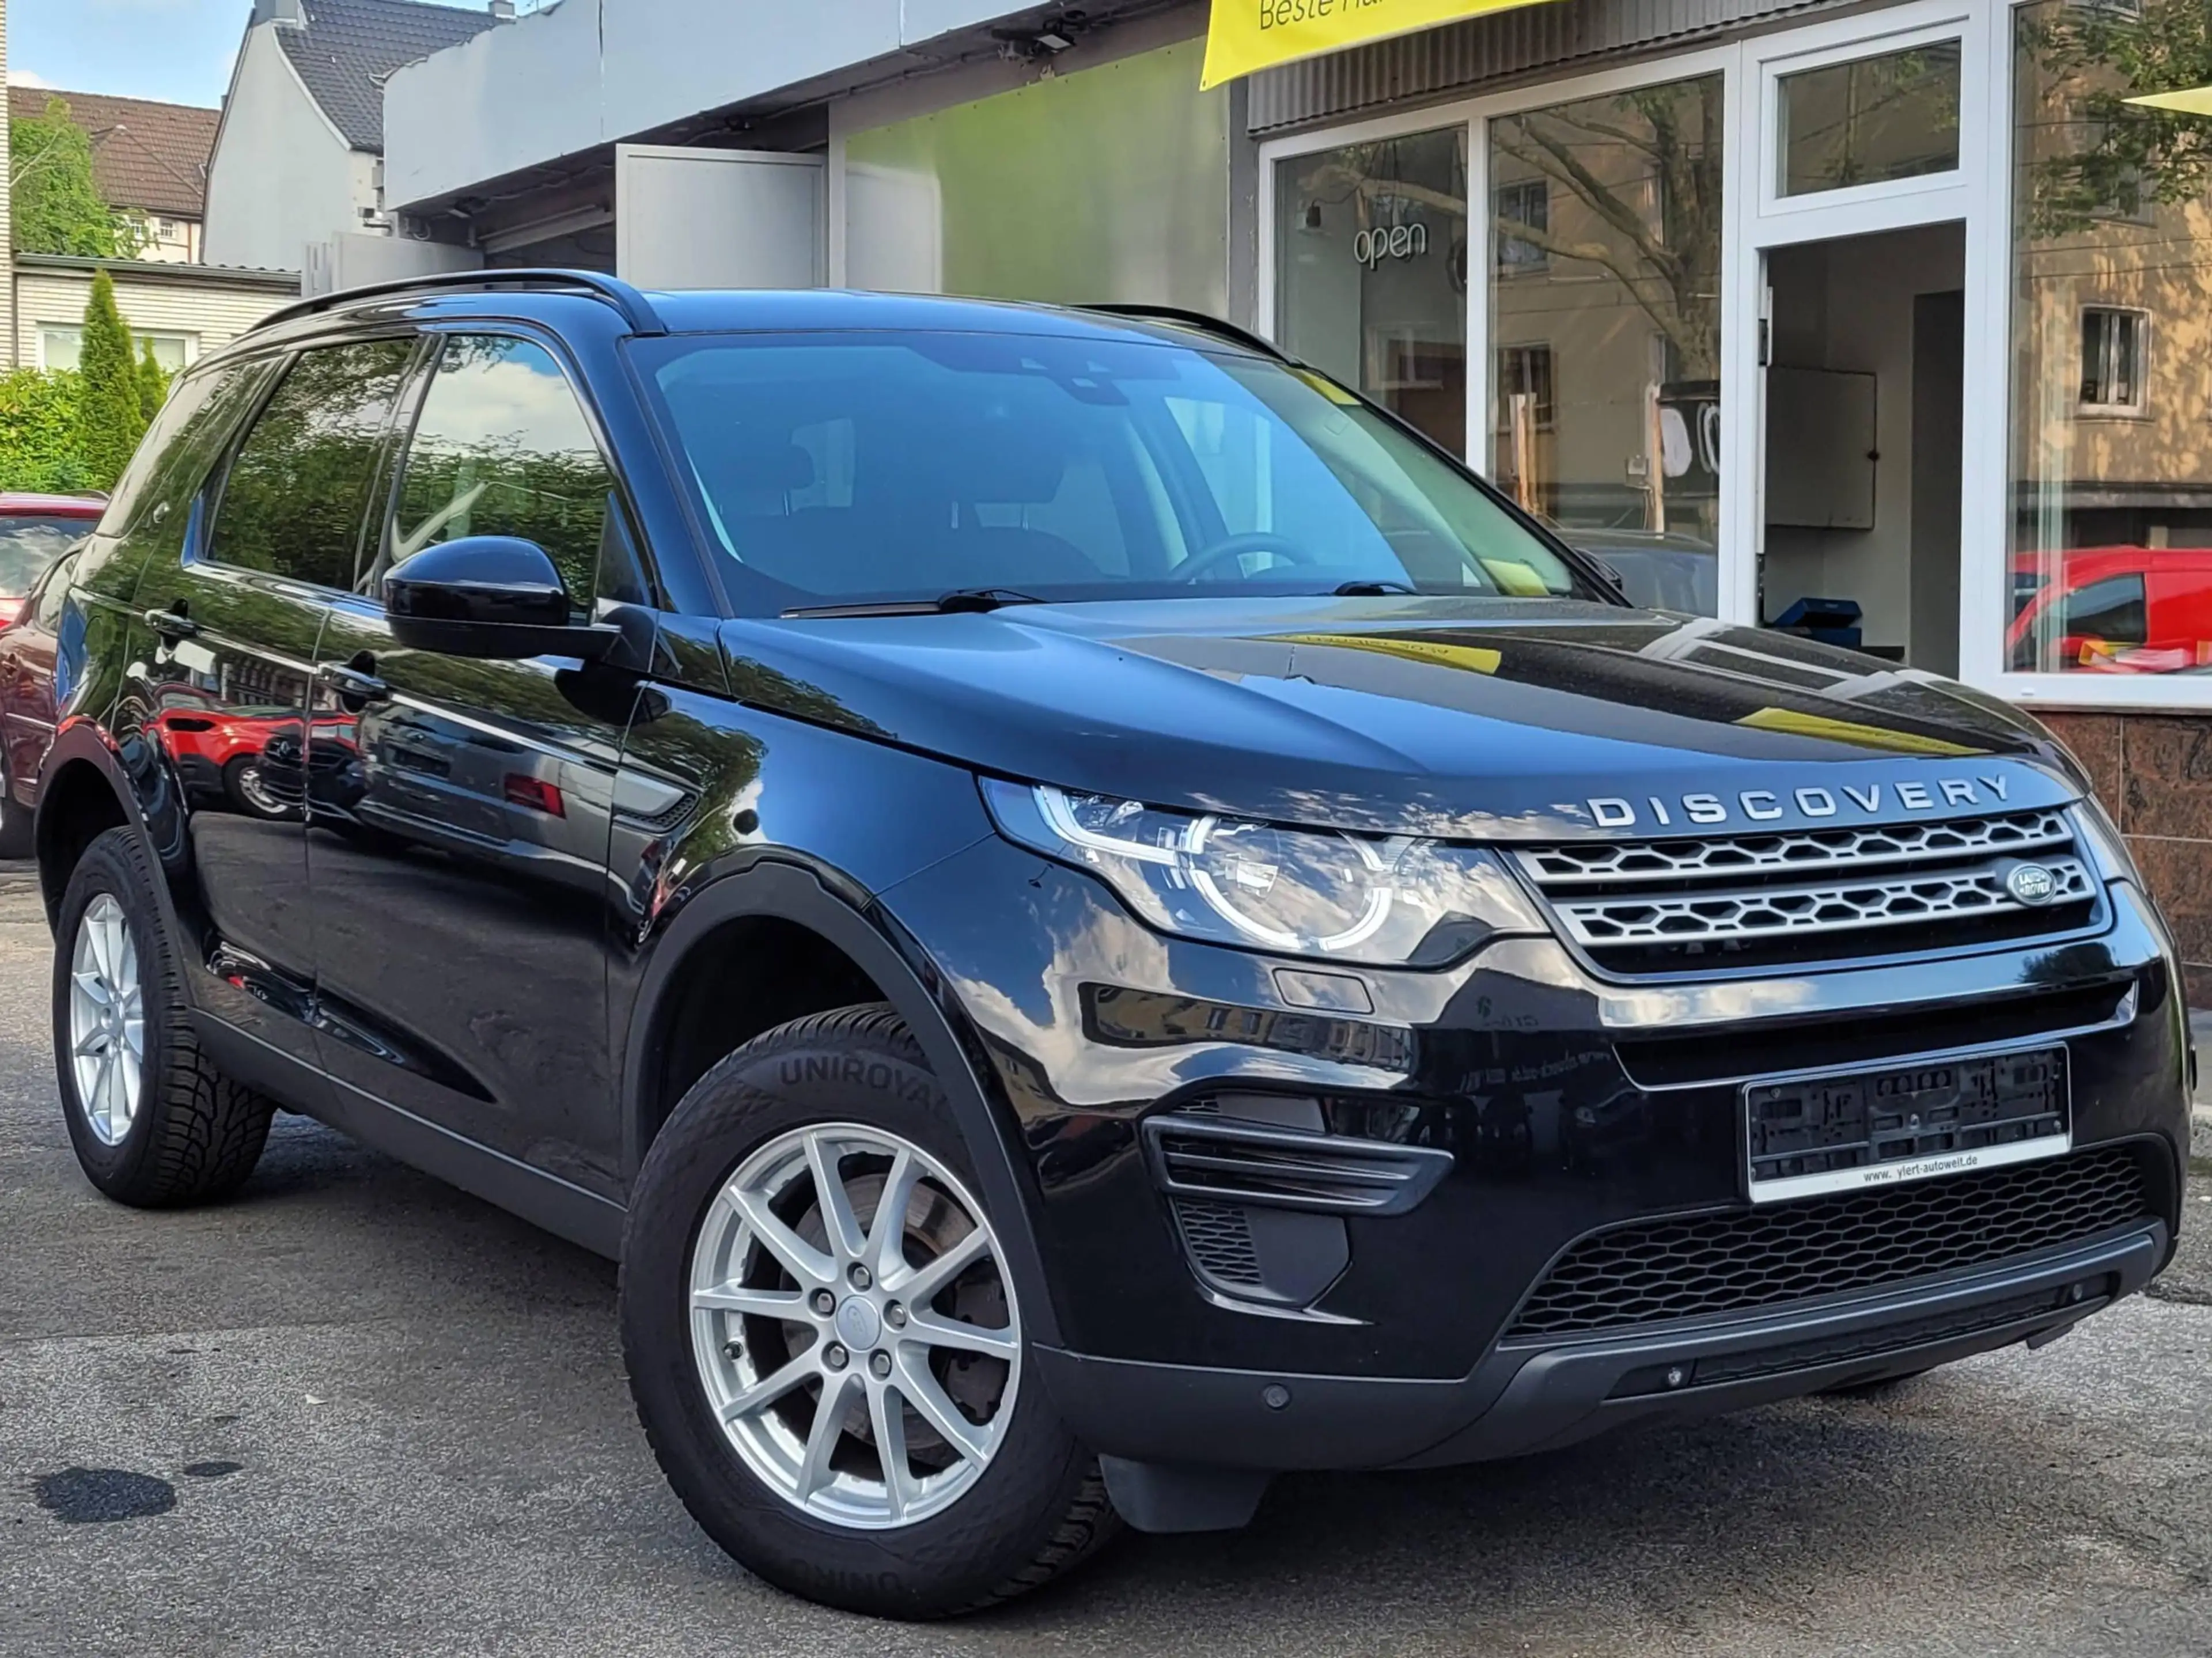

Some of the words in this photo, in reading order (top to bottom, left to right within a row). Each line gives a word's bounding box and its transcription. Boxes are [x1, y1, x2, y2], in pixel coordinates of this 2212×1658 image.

[1354, 223, 1426, 270] open
[1585, 775, 2008, 828] DISCOVERY
[1863, 1169, 1892, 1182] www.
